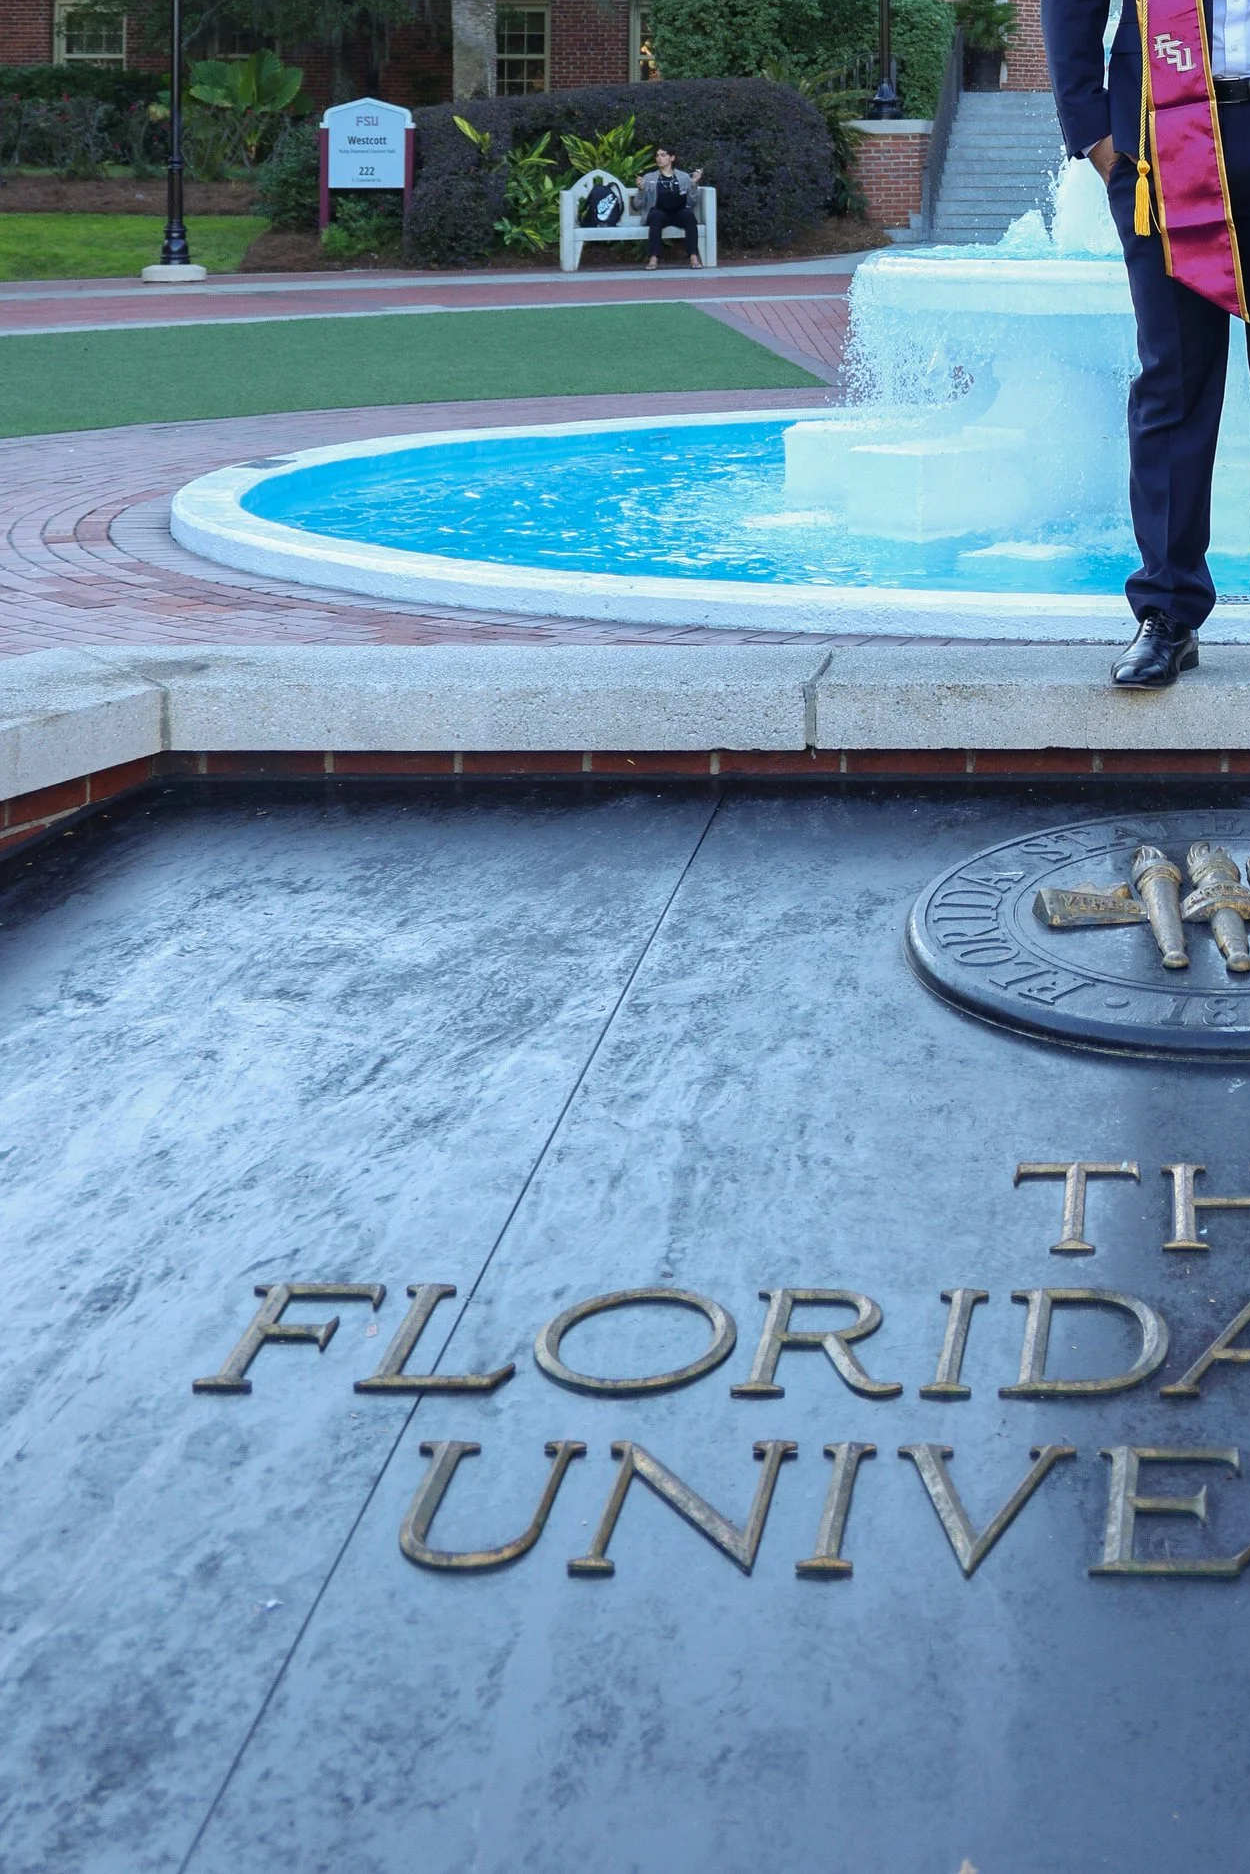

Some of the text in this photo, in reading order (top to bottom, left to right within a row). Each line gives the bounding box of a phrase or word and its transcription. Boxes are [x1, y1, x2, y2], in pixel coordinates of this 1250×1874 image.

[1153, 33, 1194, 72] FSU
[355, 116, 379, 126] FSU
[347, 135, 387, 145] Westcott
[359, 166, 375, 176] 222
[933, 872, 1095, 1006] FLORIDA
